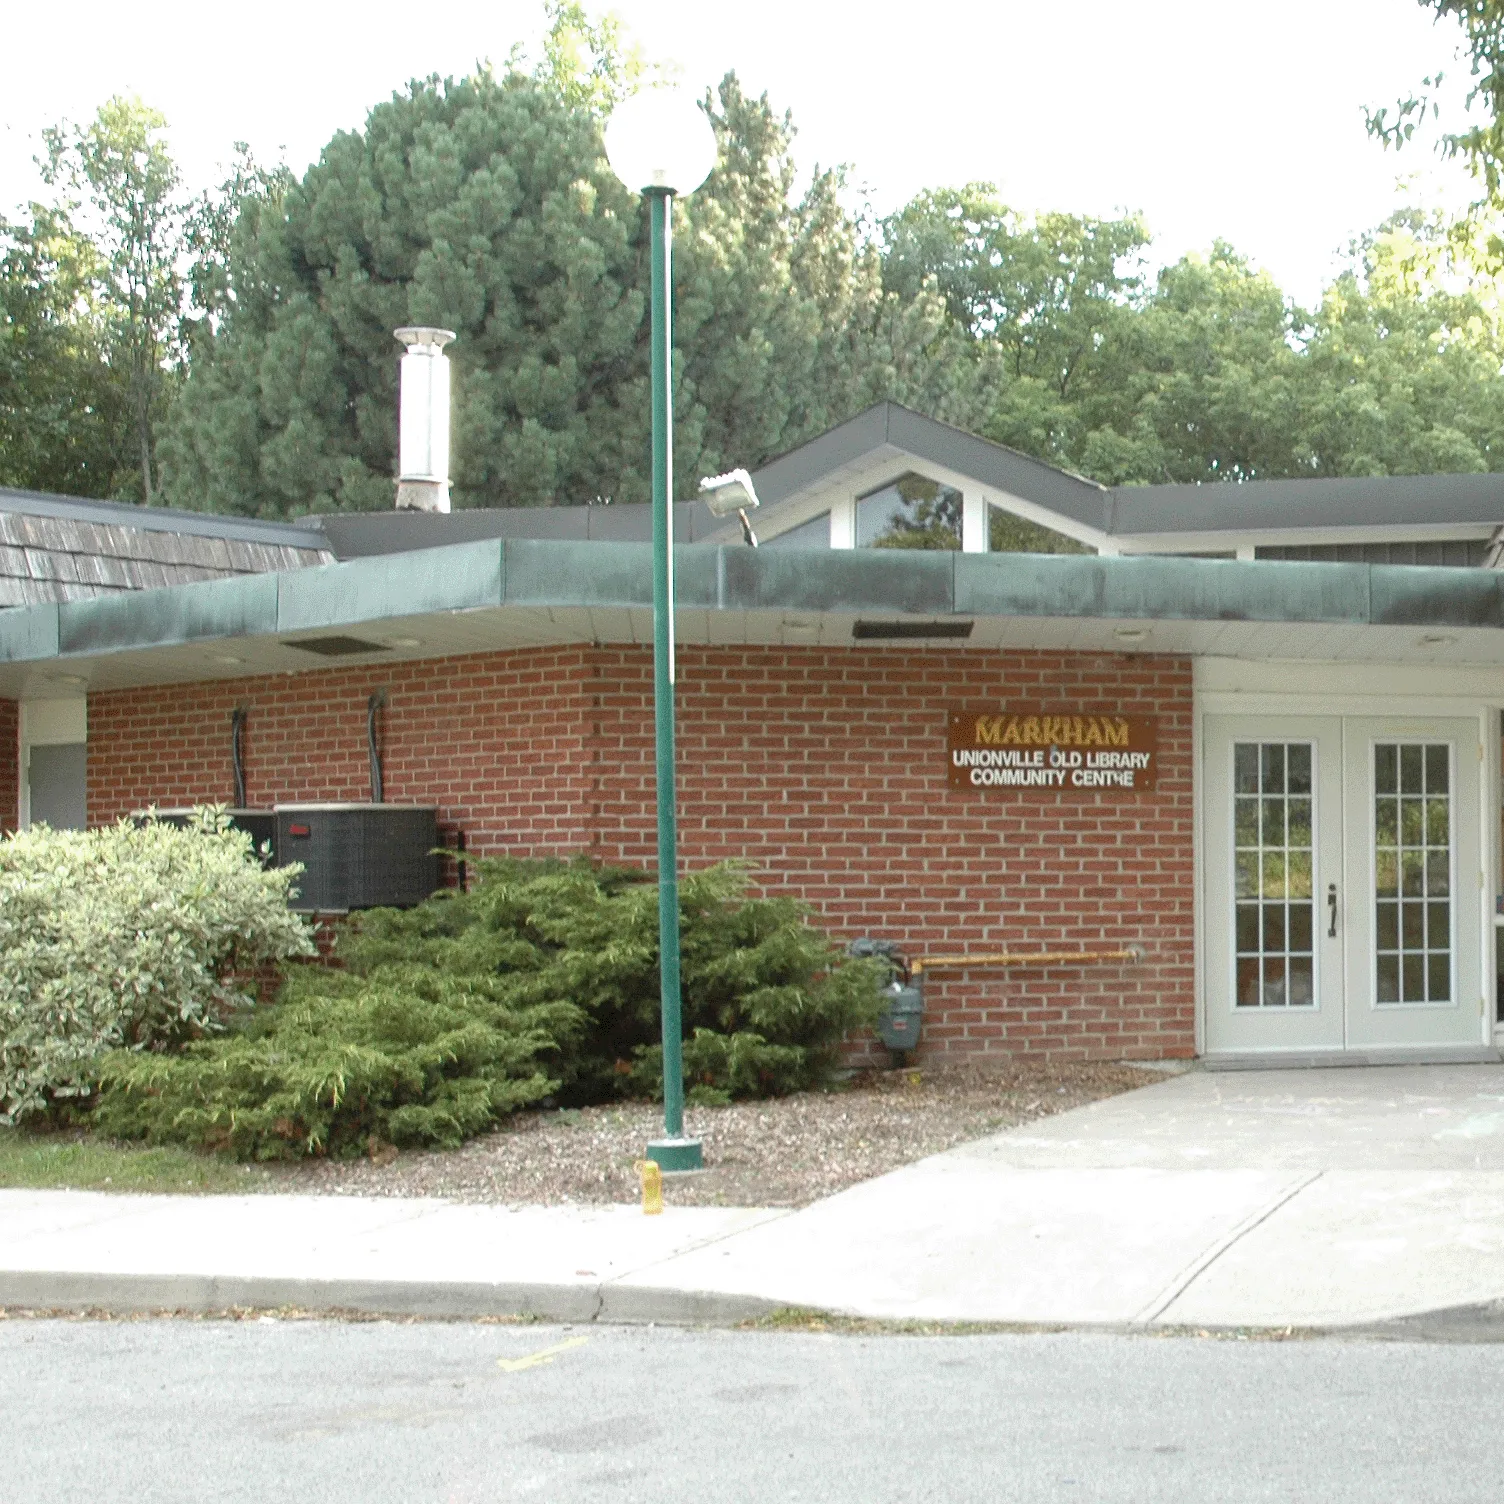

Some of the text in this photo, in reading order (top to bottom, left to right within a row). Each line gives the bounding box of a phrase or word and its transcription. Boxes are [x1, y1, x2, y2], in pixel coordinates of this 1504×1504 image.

[975, 715, 1129, 746] MARKHAM
[952, 749, 1151, 769] UNIONVILLE OLD LIBRARY
[970, 769, 1066, 786] COMMUNITY
